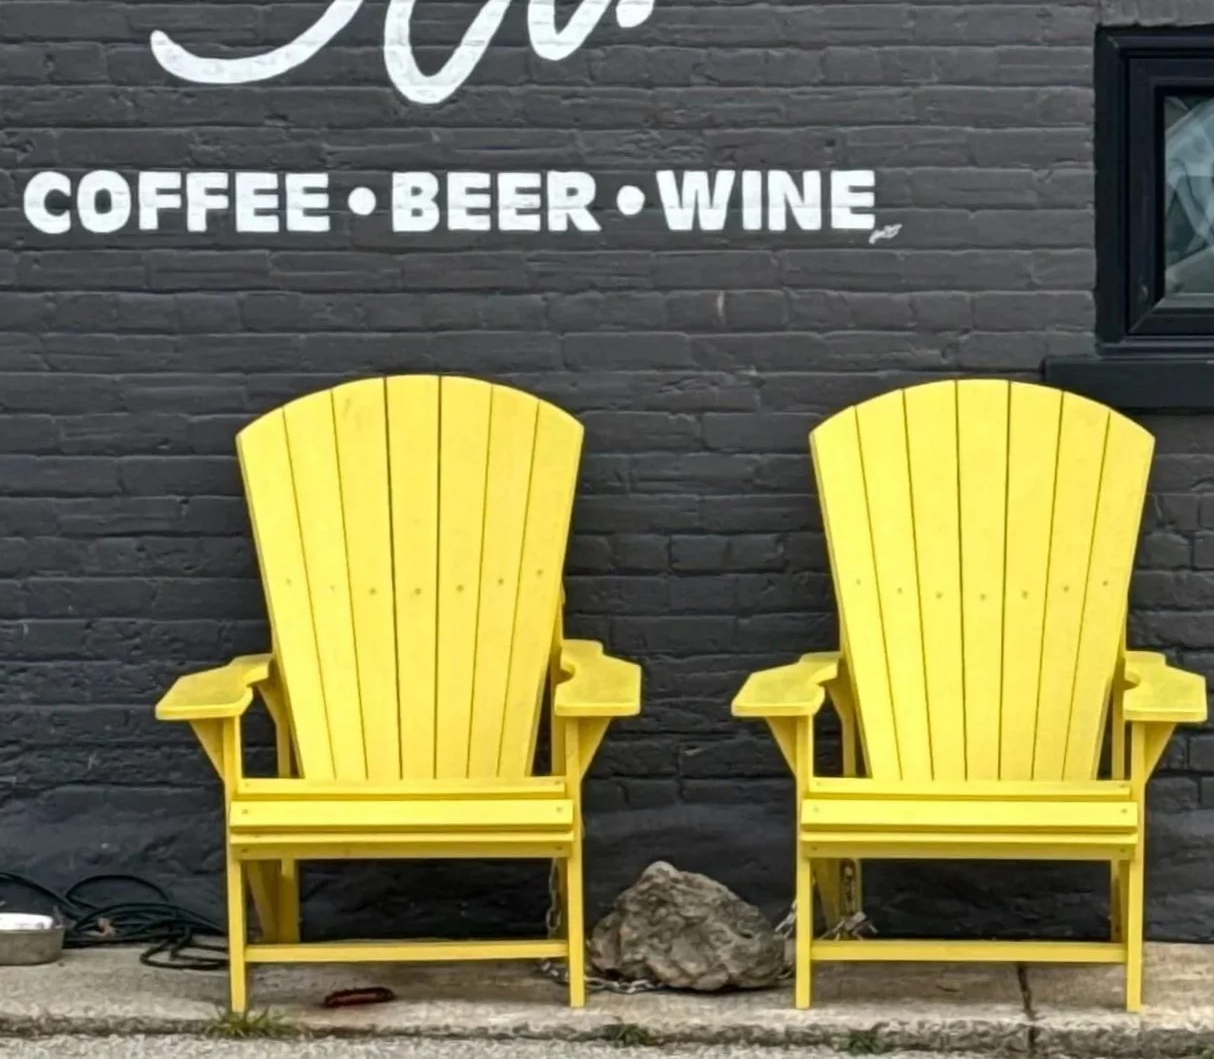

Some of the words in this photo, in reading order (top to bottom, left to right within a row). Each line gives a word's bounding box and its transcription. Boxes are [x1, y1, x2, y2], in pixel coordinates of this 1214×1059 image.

[24, 170, 330, 234] COFFEE
[392, 170, 601, 232] BEER
[656, 170, 876, 231] WINE
